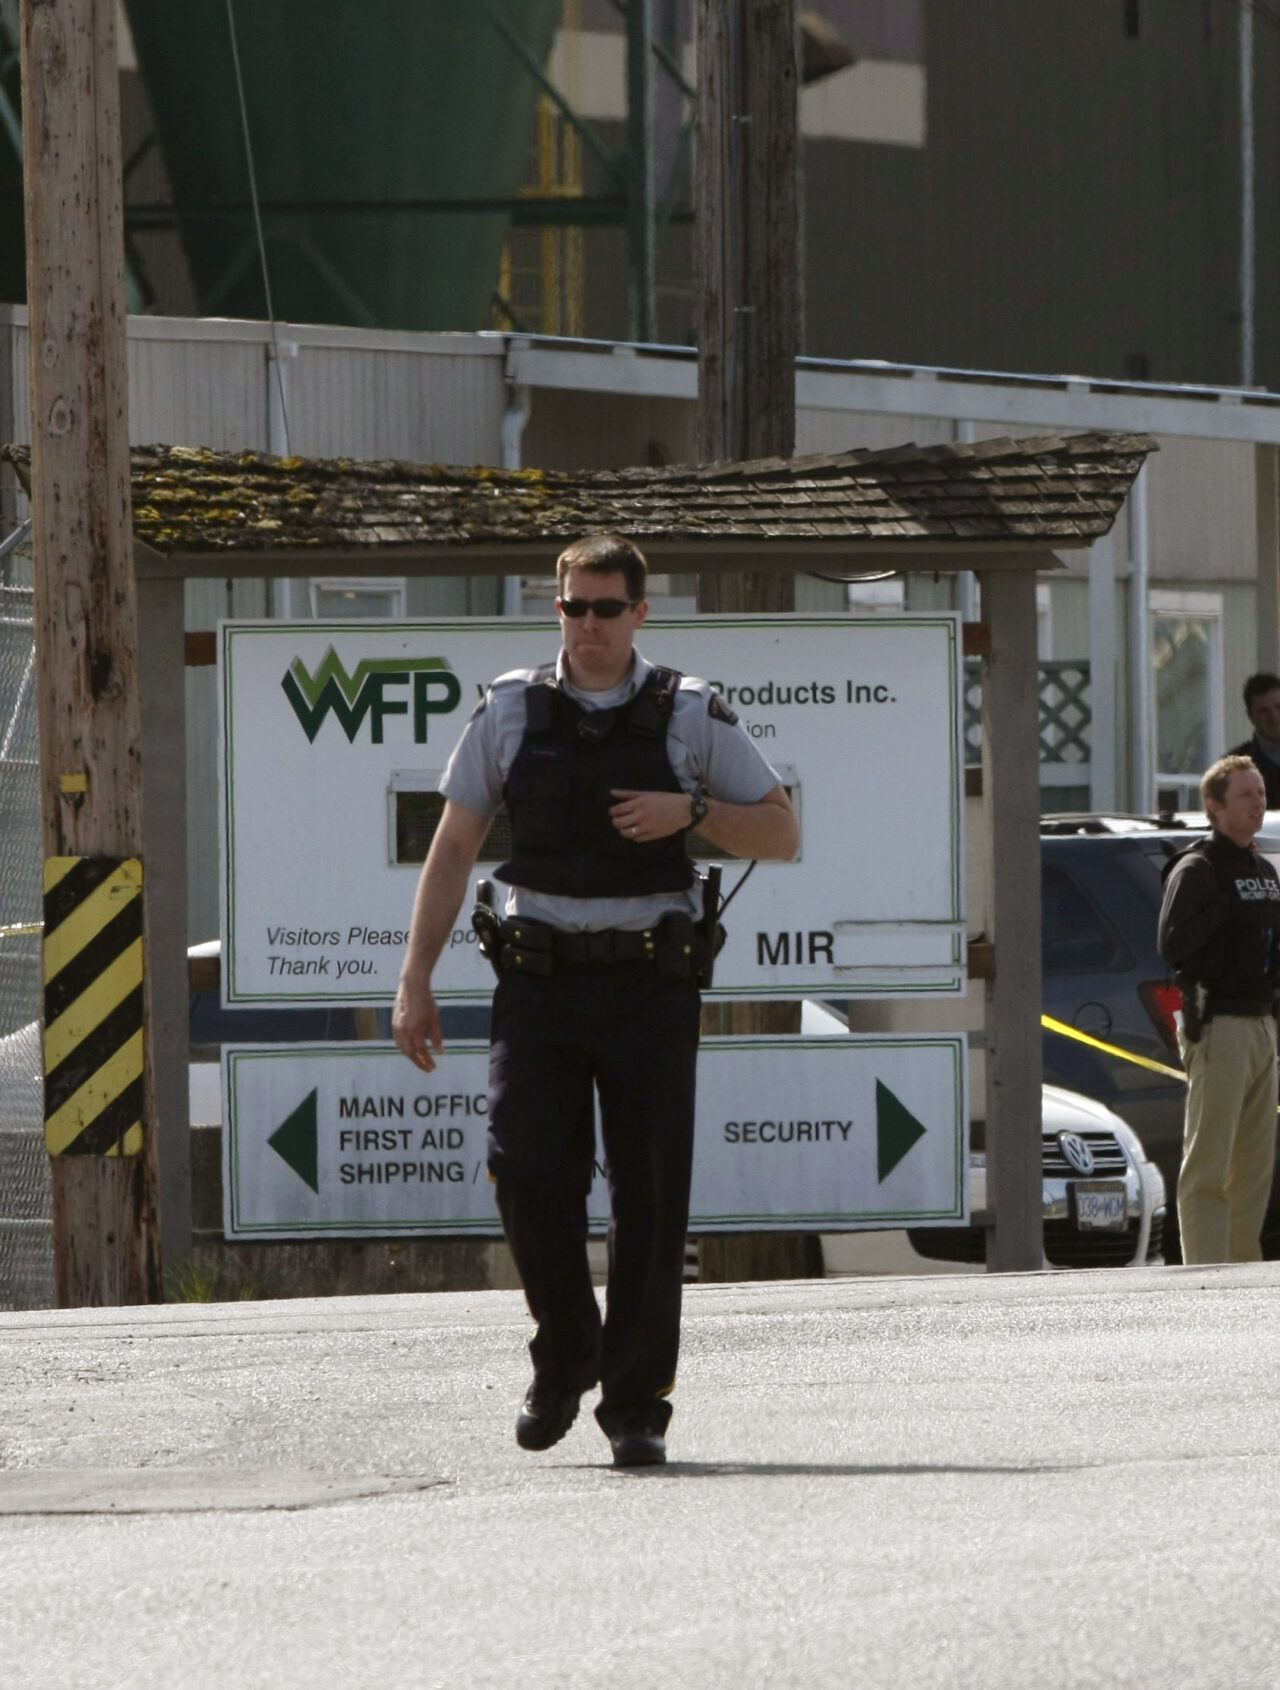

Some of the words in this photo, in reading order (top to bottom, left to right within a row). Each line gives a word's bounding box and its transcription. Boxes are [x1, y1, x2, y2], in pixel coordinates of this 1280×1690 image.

[281, 643, 461, 745] WFP
[846, 679, 897, 704] Inc.
[1235, 878, 1279, 892] POLCE
[266, 927, 341, 946] Visitors
[757, 931, 834, 965] MIR
[267, 956, 331, 976] Thank
[336, 959, 378, 980] you.
[339, 1096, 404, 1118] MAIN
[413, 1094, 488, 1118] OFFIC
[339, 1129, 413, 1151] FIRST
[421, 1128, 464, 1150] AID
[724, 1120, 853, 1144] SECURITY
[339, 1161, 465, 1184] SHIPPING
